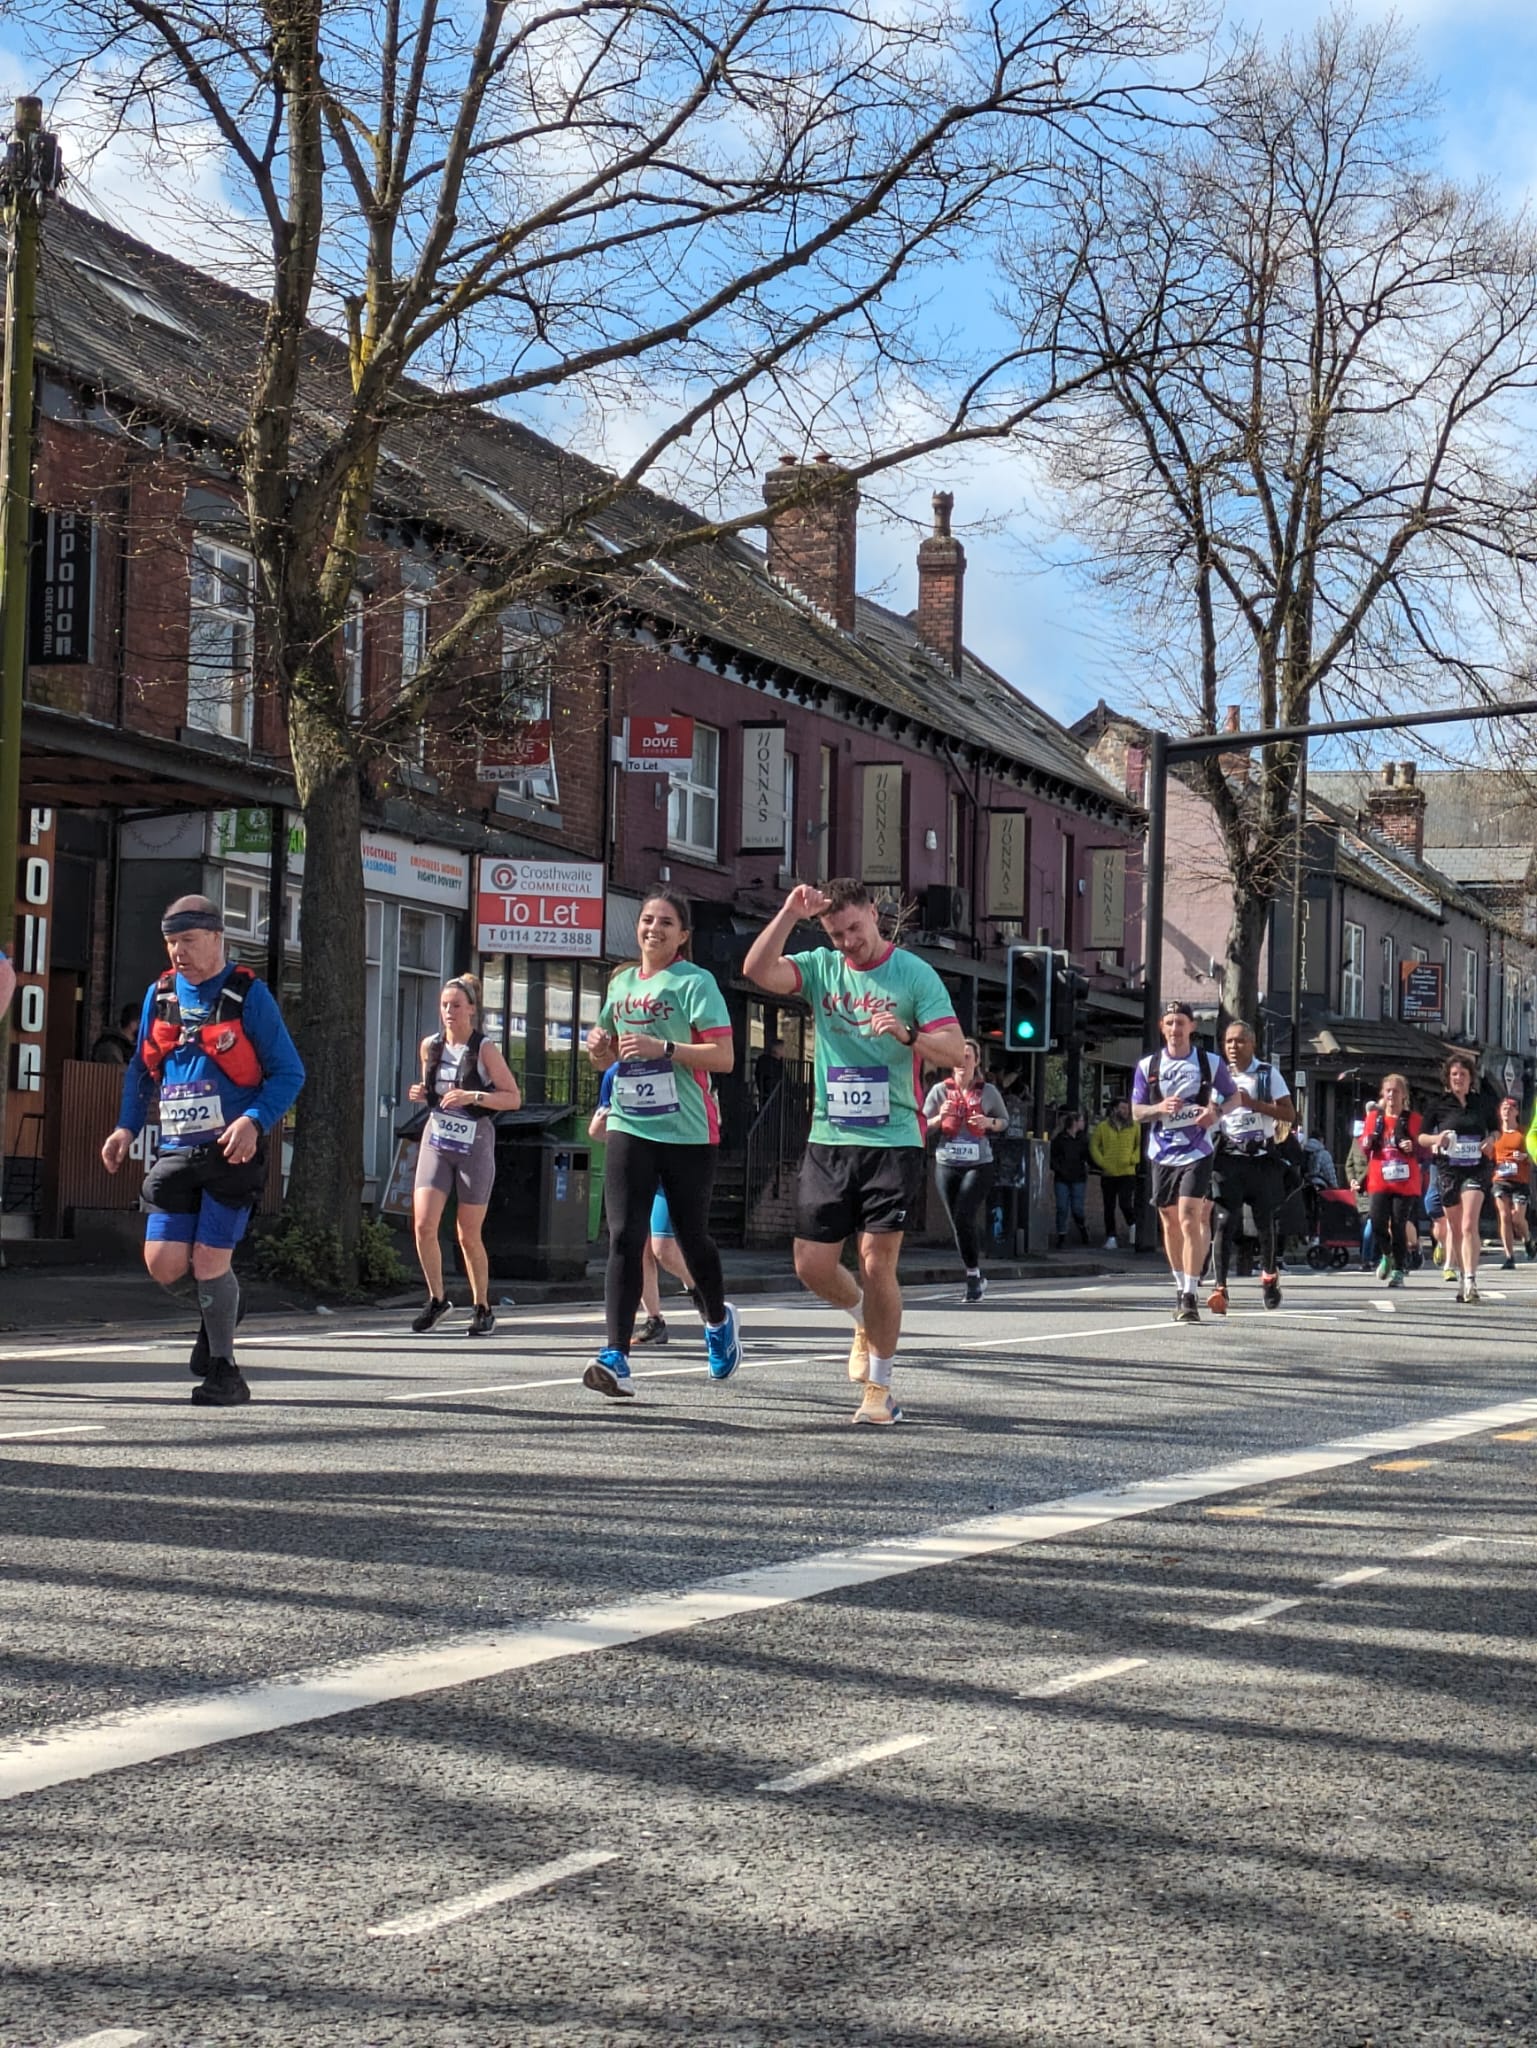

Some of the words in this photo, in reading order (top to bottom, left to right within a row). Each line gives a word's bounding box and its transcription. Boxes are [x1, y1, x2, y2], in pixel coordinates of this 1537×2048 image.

[43, 624, 53, 656] GRILL
[643, 737, 679, 748] DOVE
[628, 761, 641, 770] To
[642, 761, 658, 770] Let
[520, 865, 592, 881] Crosthwaite
[438, 875, 462, 890] POVERTY
[520, 881, 592, 893] COMMERCIAL
[499, 896, 530, 923] To
[539, 898, 580, 926] Let
[488, 928, 496, 941] T
[500, 929, 529, 943] 0114
[534, 931, 557, 943] 272
[561, 932, 592, 945] 3888
[635, 1083, 655, 1097] 92
[841, 1090, 873, 1106] 102
[170, 1105, 210, 1123] 2292
[438, 1119, 468, 1134] 3629
